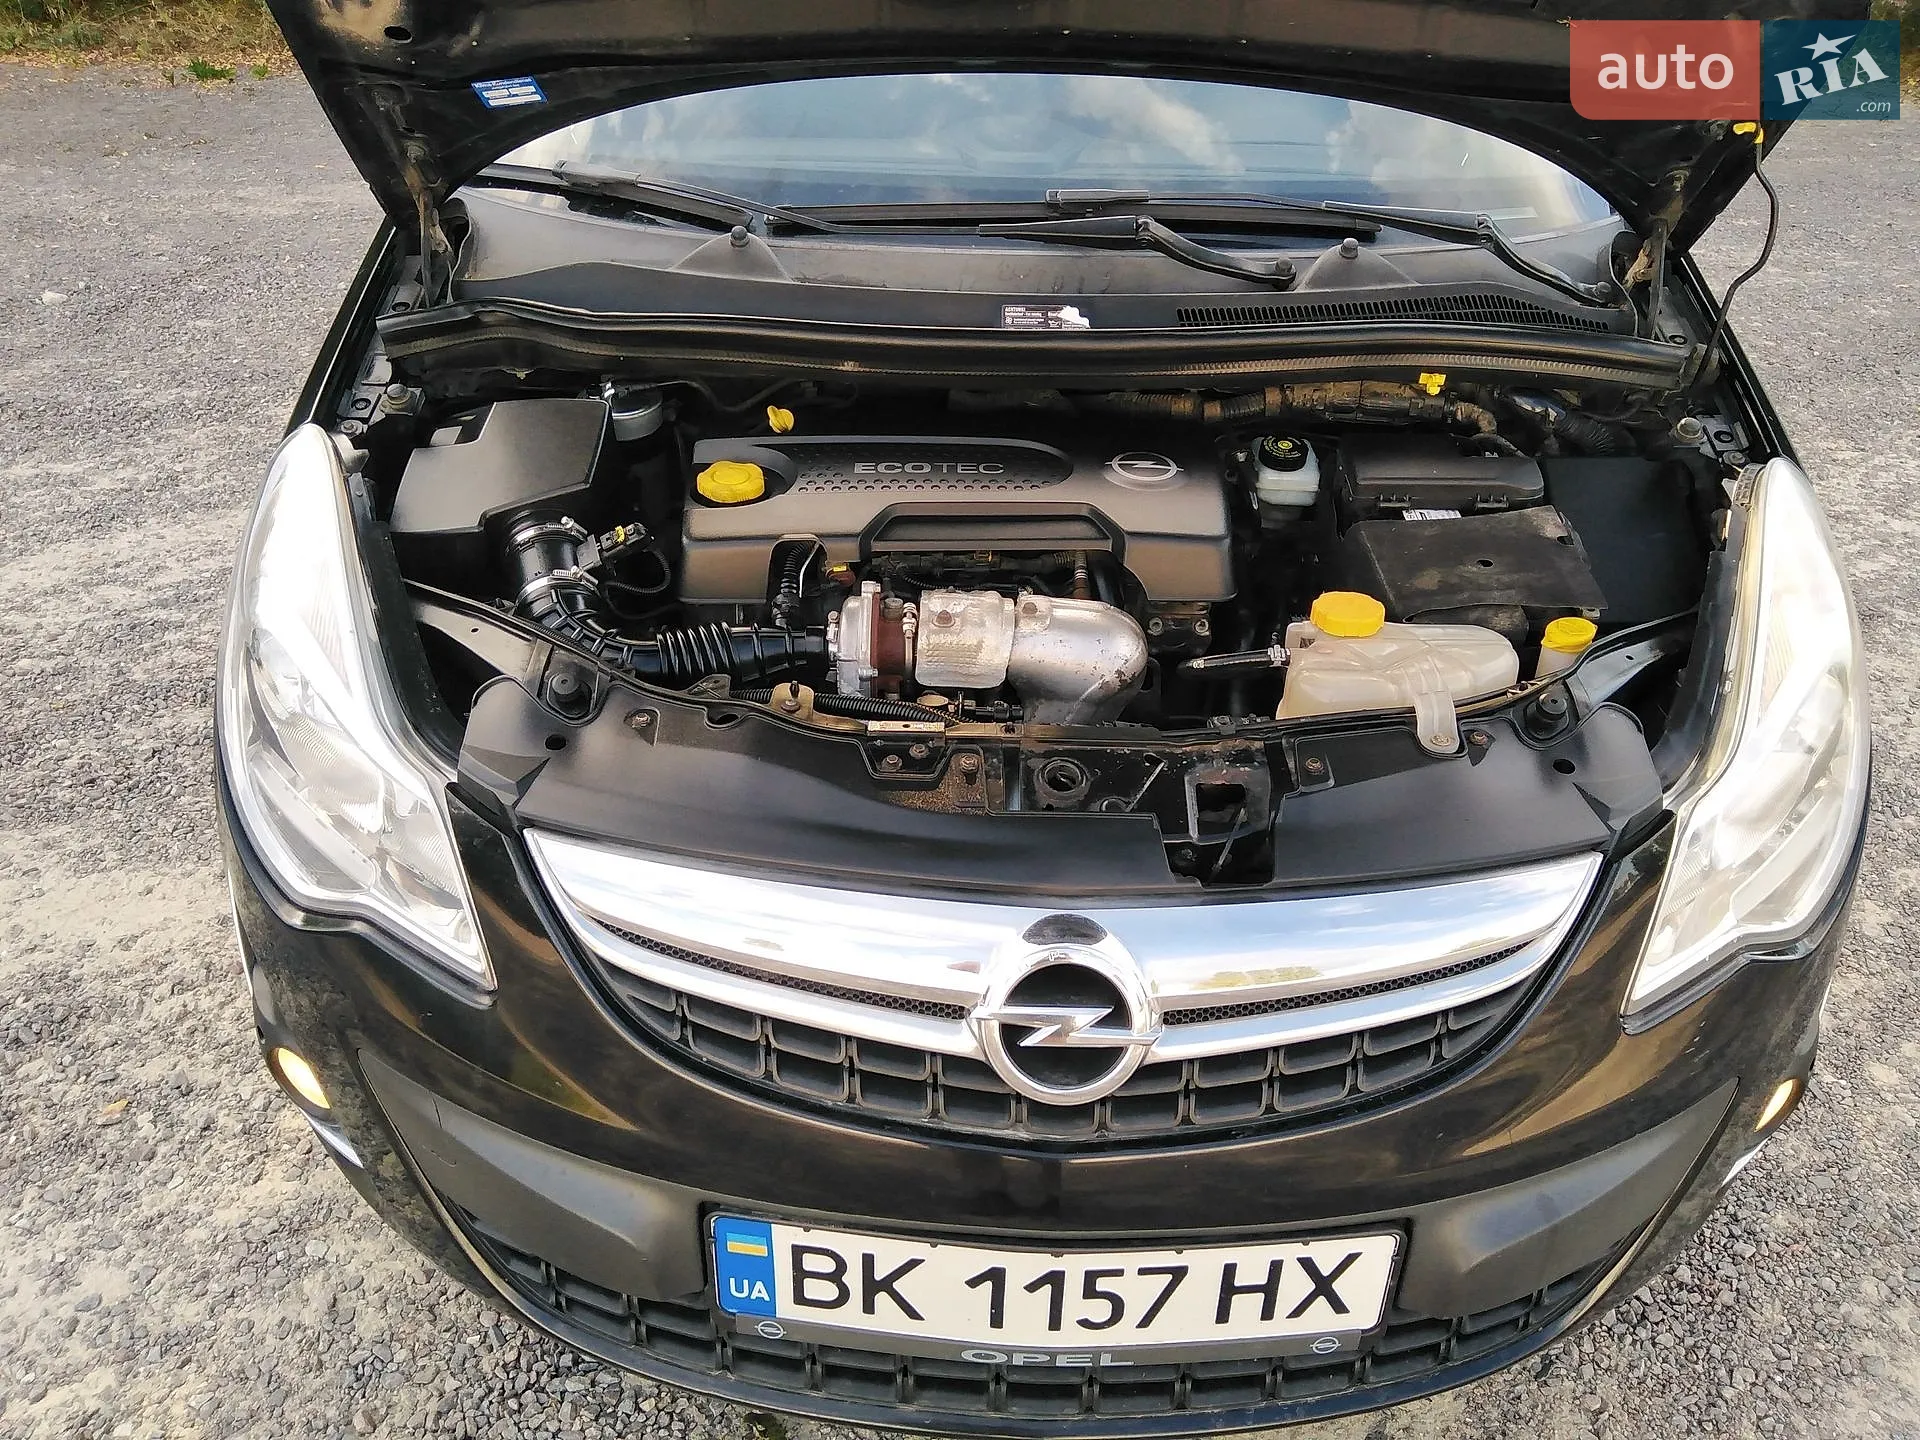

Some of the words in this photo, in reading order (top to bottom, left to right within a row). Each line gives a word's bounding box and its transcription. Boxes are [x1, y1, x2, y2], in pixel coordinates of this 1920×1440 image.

[853, 461, 1005, 475] ECOTEC
[729, 1279, 770, 1301] UA
[792, 1244, 926, 1321] BK
[965, 1265, 1189, 1332] 1157
[1215, 1251, 1362, 1325] HX
[961, 1348, 1134, 1367] OPEL
